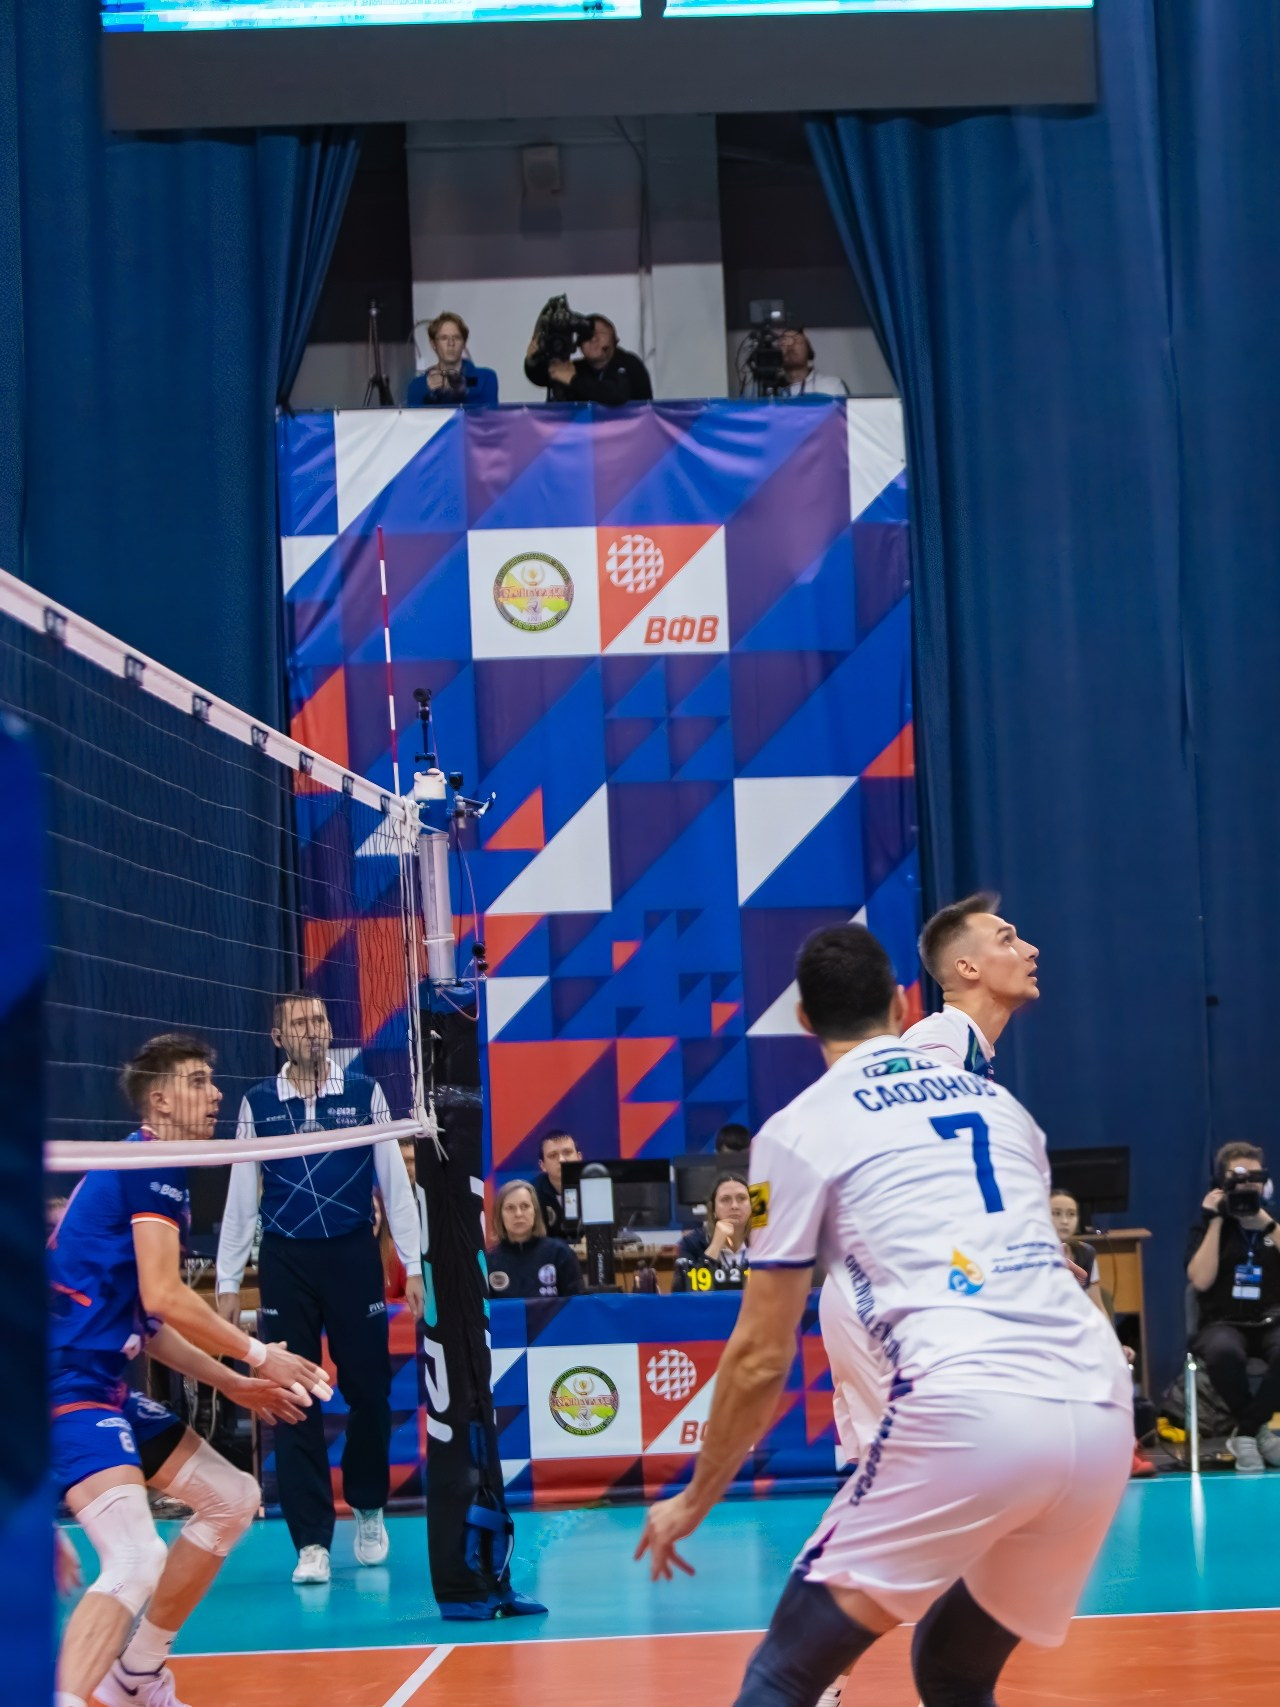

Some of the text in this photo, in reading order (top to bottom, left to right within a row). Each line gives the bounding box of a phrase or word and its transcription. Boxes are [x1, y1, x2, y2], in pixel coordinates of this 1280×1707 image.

[644, 614, 720, 645] ВФВ
[852, 1074, 998, 1113] САФОНОВ
[927, 1111, 1006, 1214] 7
[687, 1267, 712, 1292] 19
[729, 1268, 741, 1282] 2
